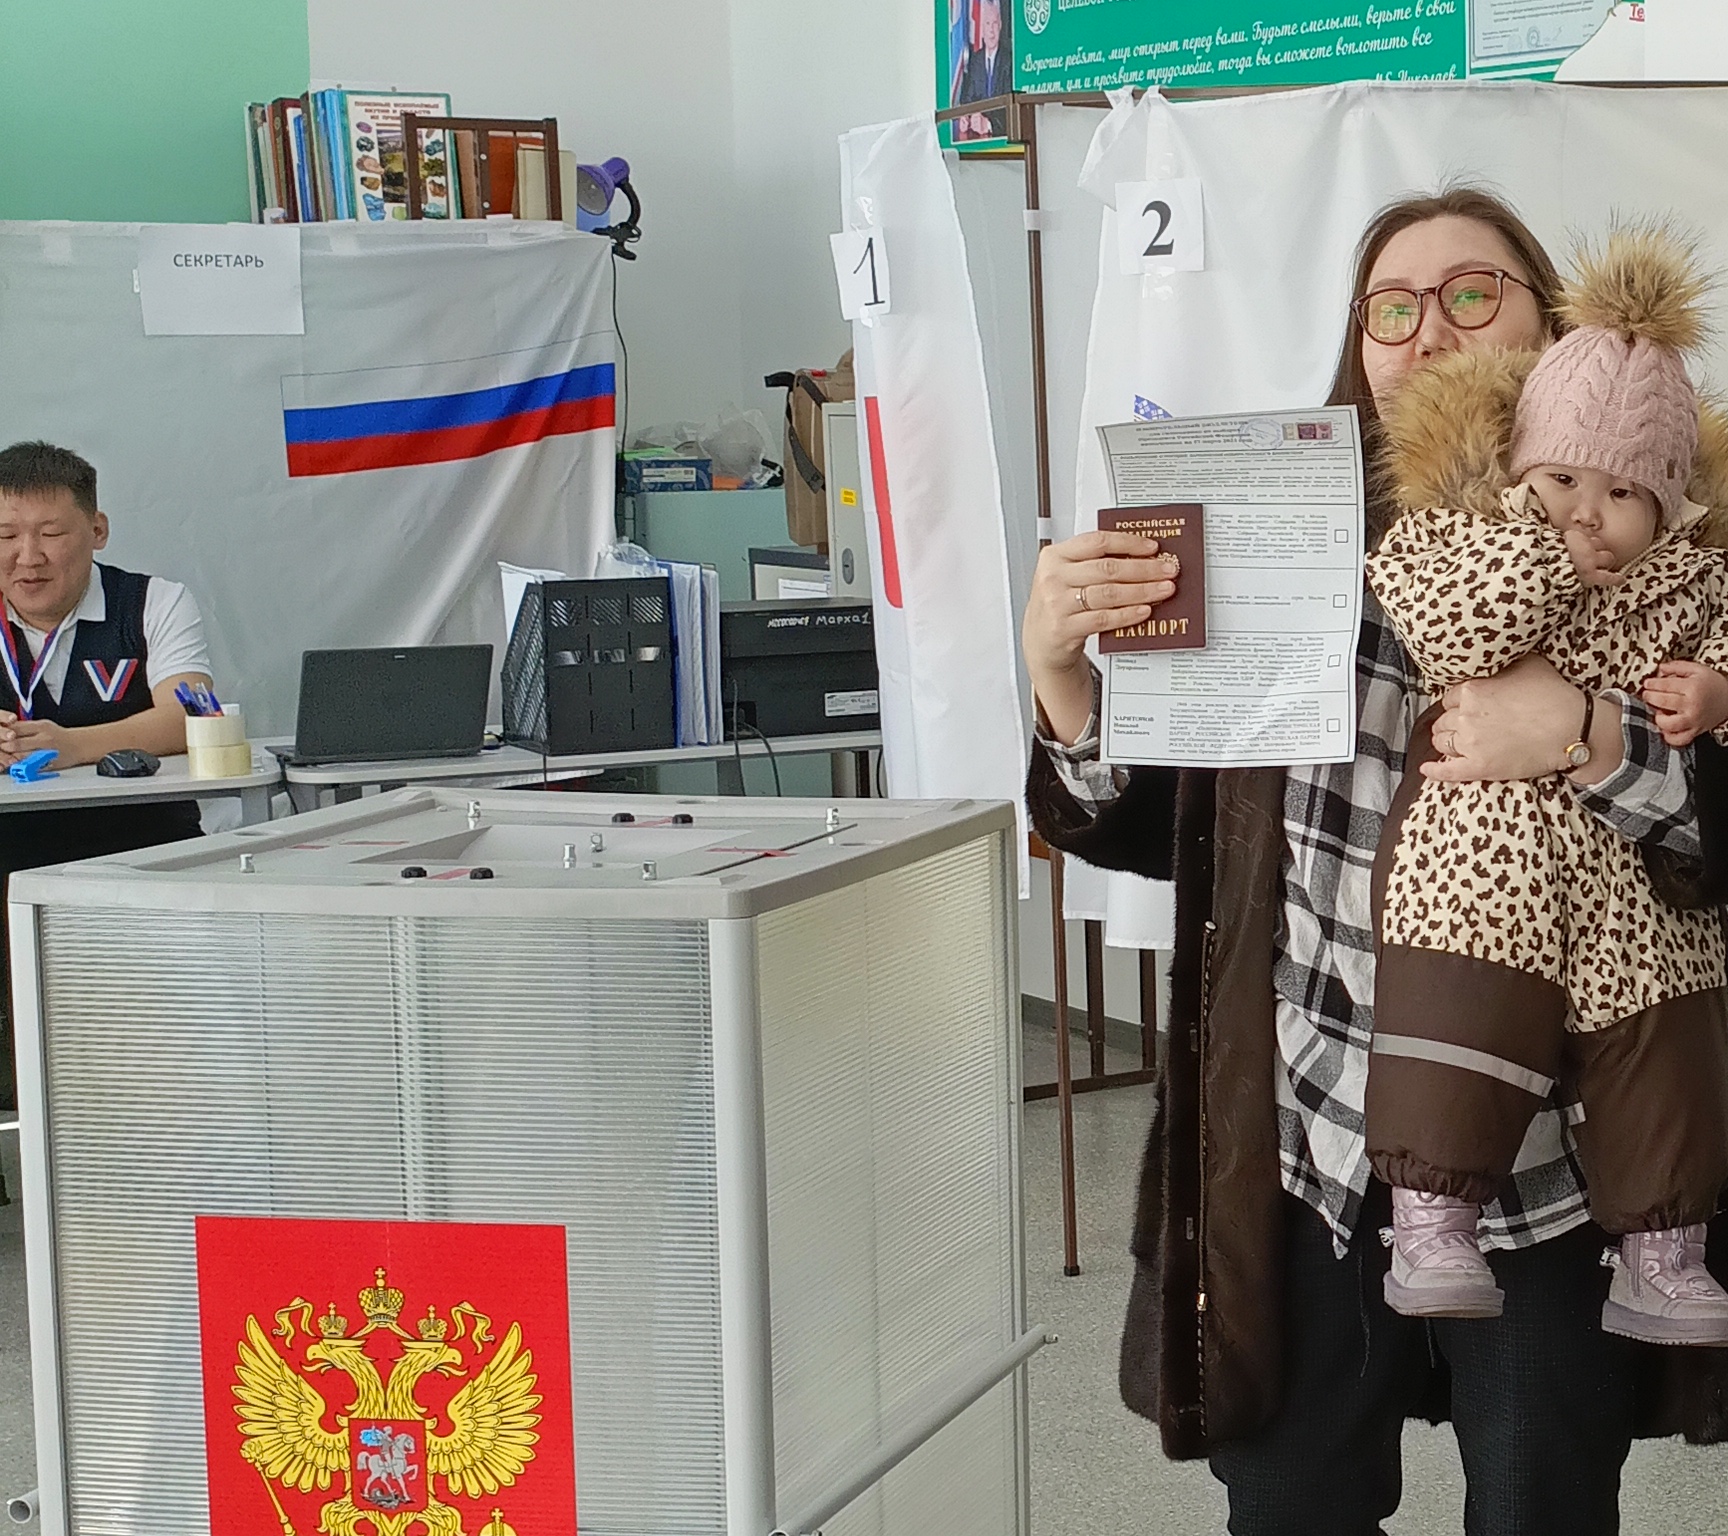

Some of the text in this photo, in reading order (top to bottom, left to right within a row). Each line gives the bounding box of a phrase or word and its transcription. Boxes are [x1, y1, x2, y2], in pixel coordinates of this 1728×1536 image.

[1108, 49, 1130, 64] мир
[1133, 40, 1180, 59] открыт
[1182, 35, 1213, 54] перед
[1216, 26, 1248, 46] вами.
[1252, 21, 1299, 45] Будьте
[1300, 14, 1362, 34] смелыми,
[1366, 5, 1412, 29] верьте
[1146, 56, 1214, 84] трудолюбие,
[1218, 57, 1253, 74] тогда
[1256, 47, 1272, 66] вы
[1274, 44, 1333, 64] сможете
[1335, 36, 1409, 56] воплотить
[1412, 26, 1433, 47] все
[1141, 200, 1176, 257] 2
[173, 253, 264, 270] СЕКРЕТАРЬ
[852, 237, 886, 307] 1
[1116, 518, 1185, 529] РОССИЙСКАЯ
